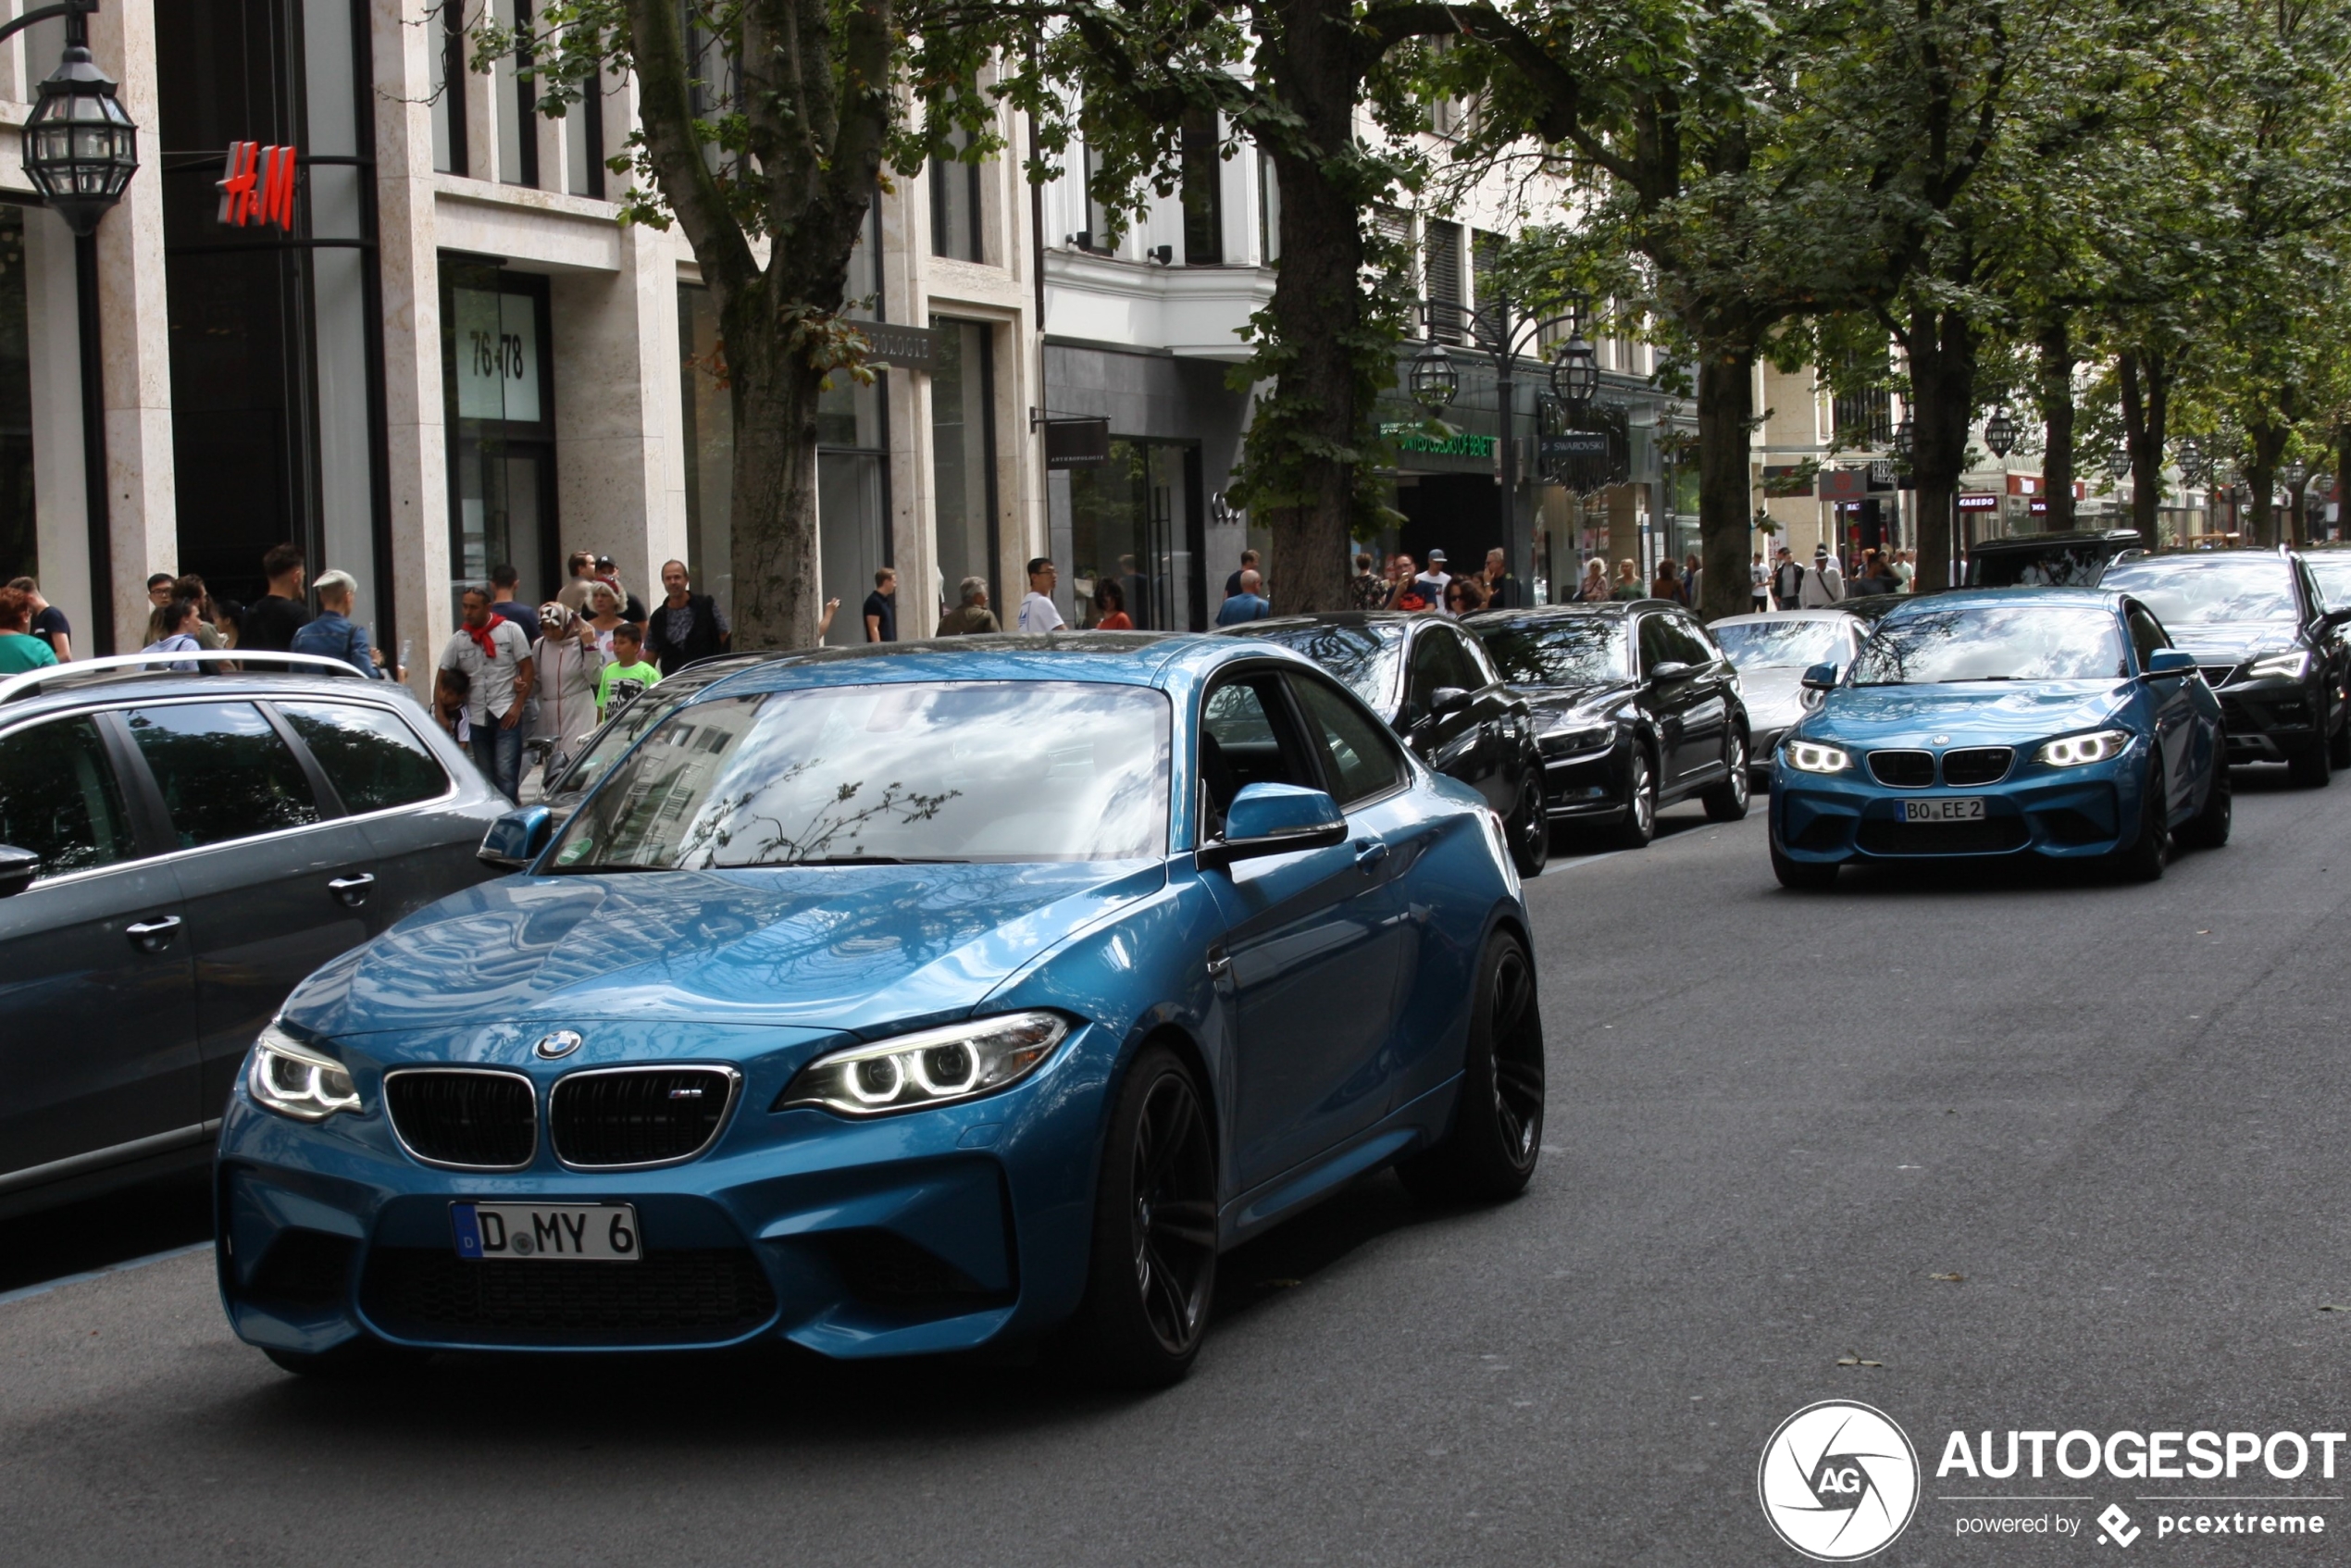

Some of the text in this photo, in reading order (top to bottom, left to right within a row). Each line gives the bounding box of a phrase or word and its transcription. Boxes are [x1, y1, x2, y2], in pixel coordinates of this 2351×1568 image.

[217, 141, 296, 231] H&M
[866, 333, 929, 359] POLOGIE
[1469, 434, 1500, 458] BENETT
[1553, 441, 1605, 452] SWAROVSKI
[1907, 801, 1982, 819] BO EE 2
[477, 1211, 635, 1253] D MY 6
